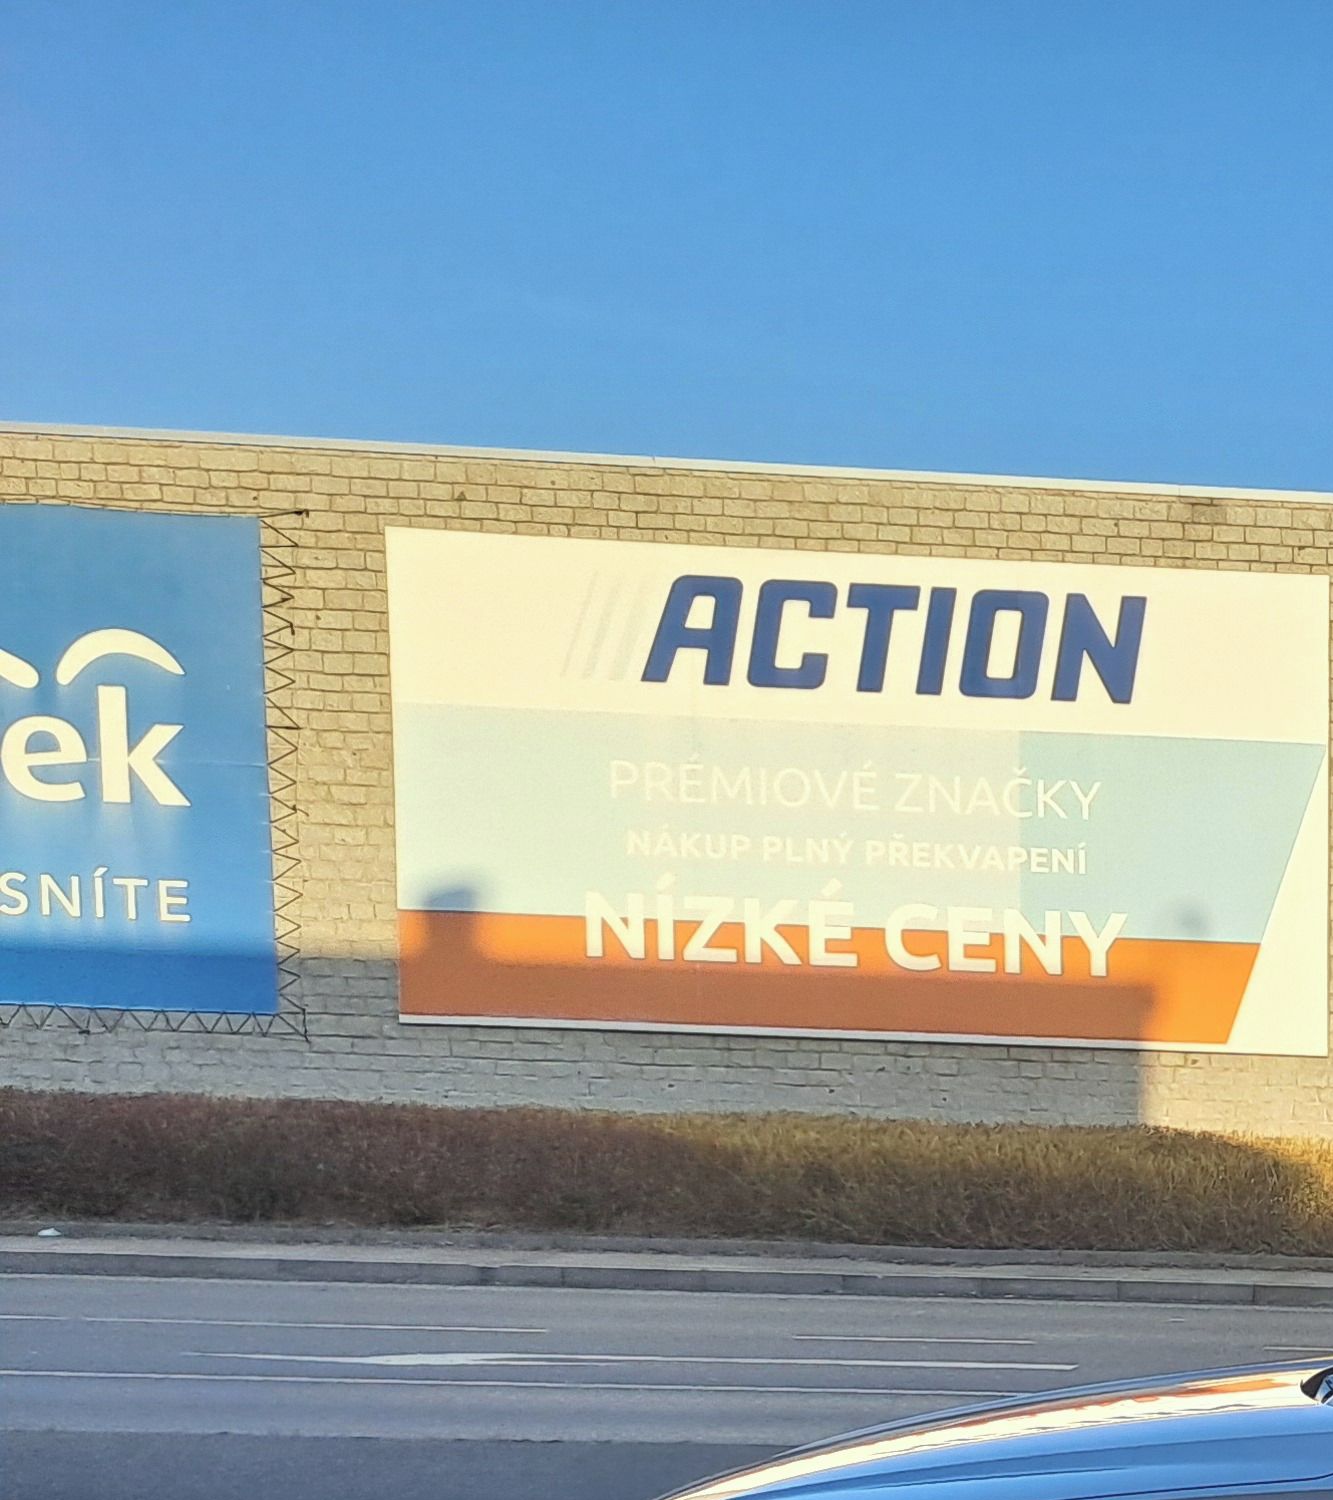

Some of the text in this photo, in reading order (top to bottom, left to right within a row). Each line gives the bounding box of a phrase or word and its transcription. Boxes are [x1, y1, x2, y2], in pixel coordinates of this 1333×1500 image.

[641, 575, 1148, 705] ACTION
[609, 753, 1102, 821] PRÉMIOVÉ ZNAČKY
[625, 823, 1088, 875] NÁKUP PLNÝ PŘEKVAPENÍ
[584, 872, 1128, 978] NÍZKÉ CENY
